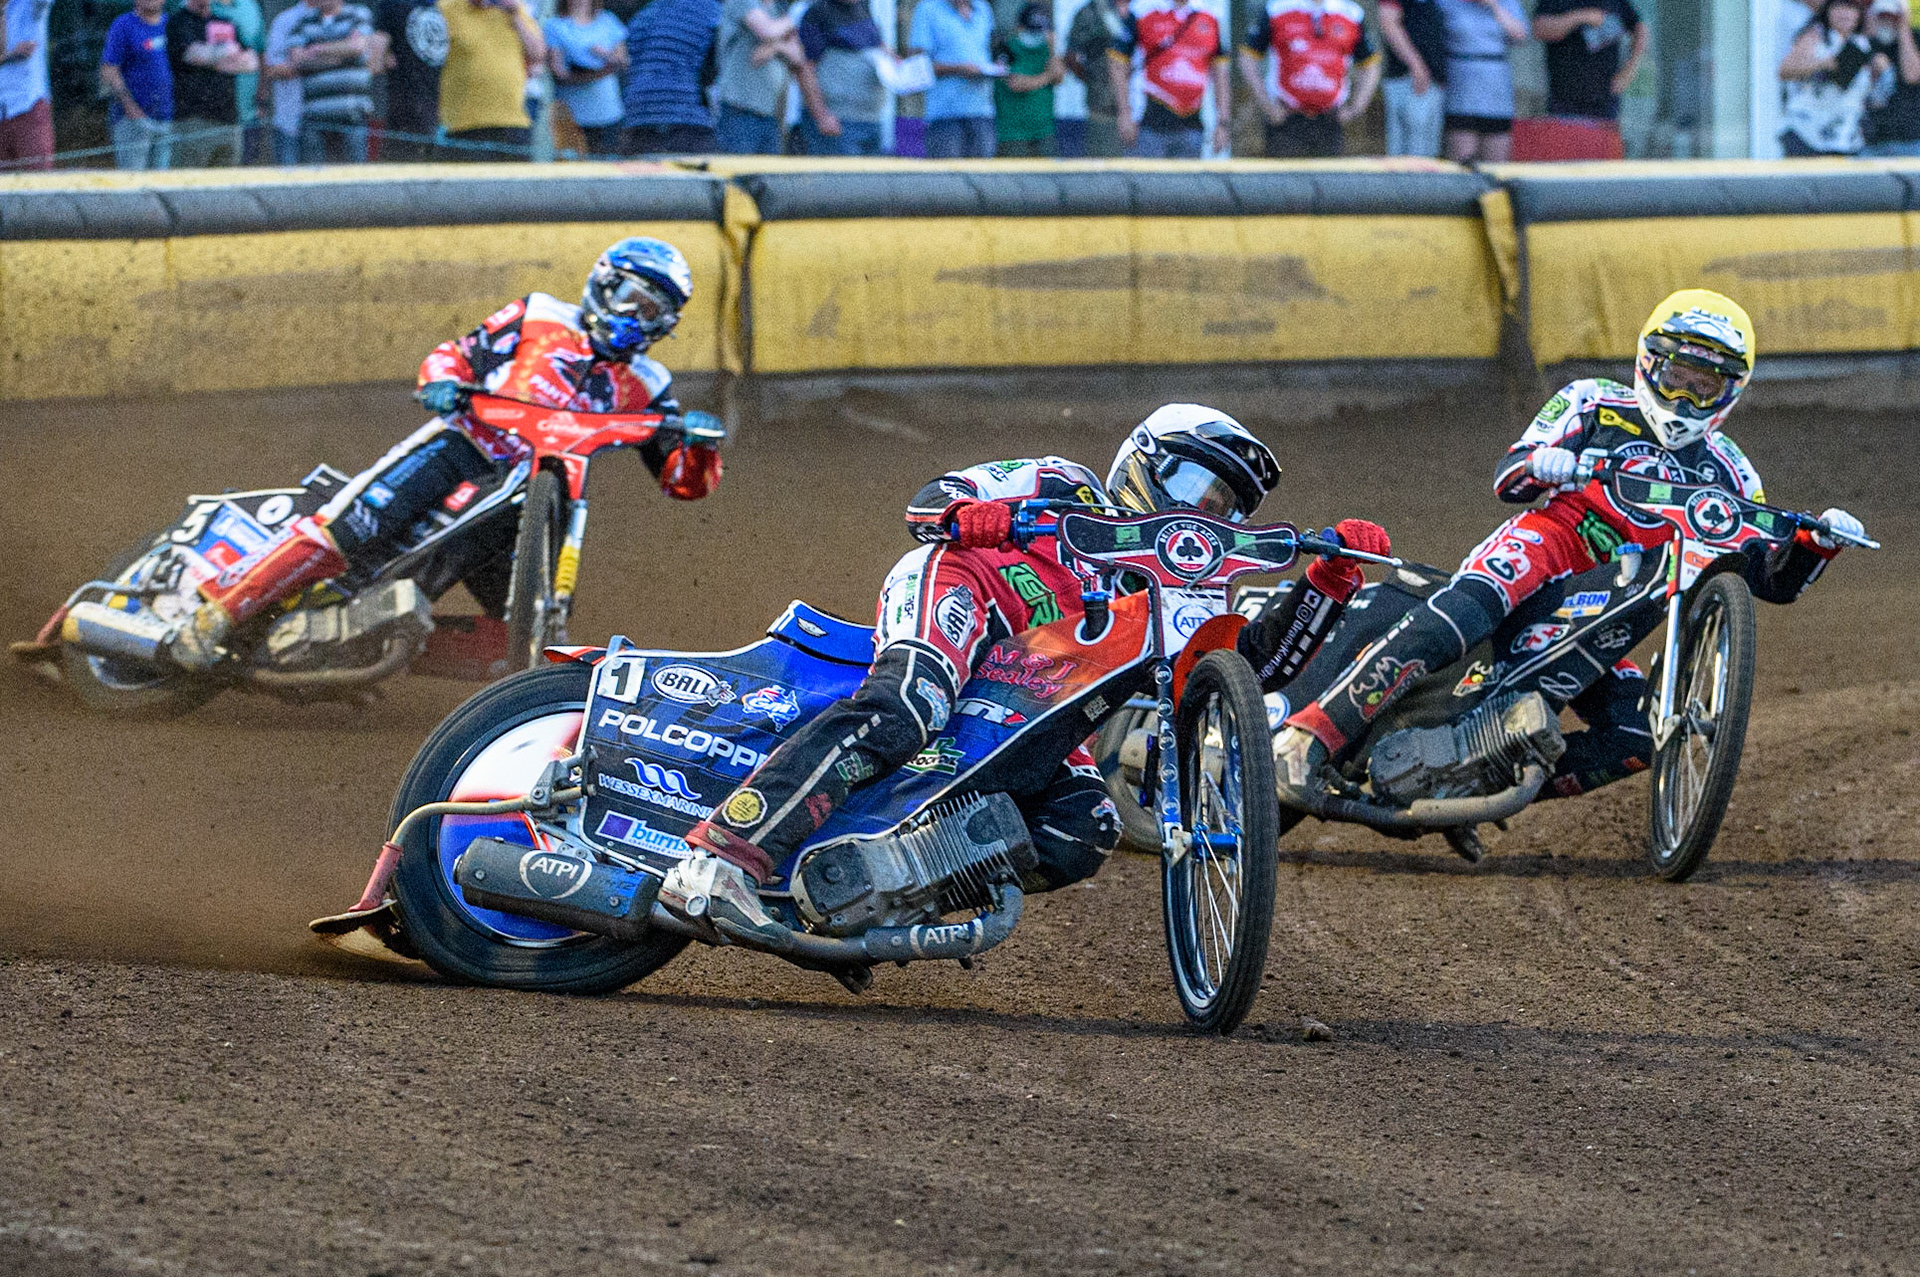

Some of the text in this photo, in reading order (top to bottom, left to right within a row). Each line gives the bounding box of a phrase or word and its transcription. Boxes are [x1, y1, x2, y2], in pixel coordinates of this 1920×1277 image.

[1200, 529, 1219, 546] ACES
[1179, 616, 1207, 629] ATP
[987, 644, 1078, 681] M & J
[610, 661, 630, 696] 1
[973, 660, 1064, 699] Sealey
[530, 856, 579, 880] ATPI
